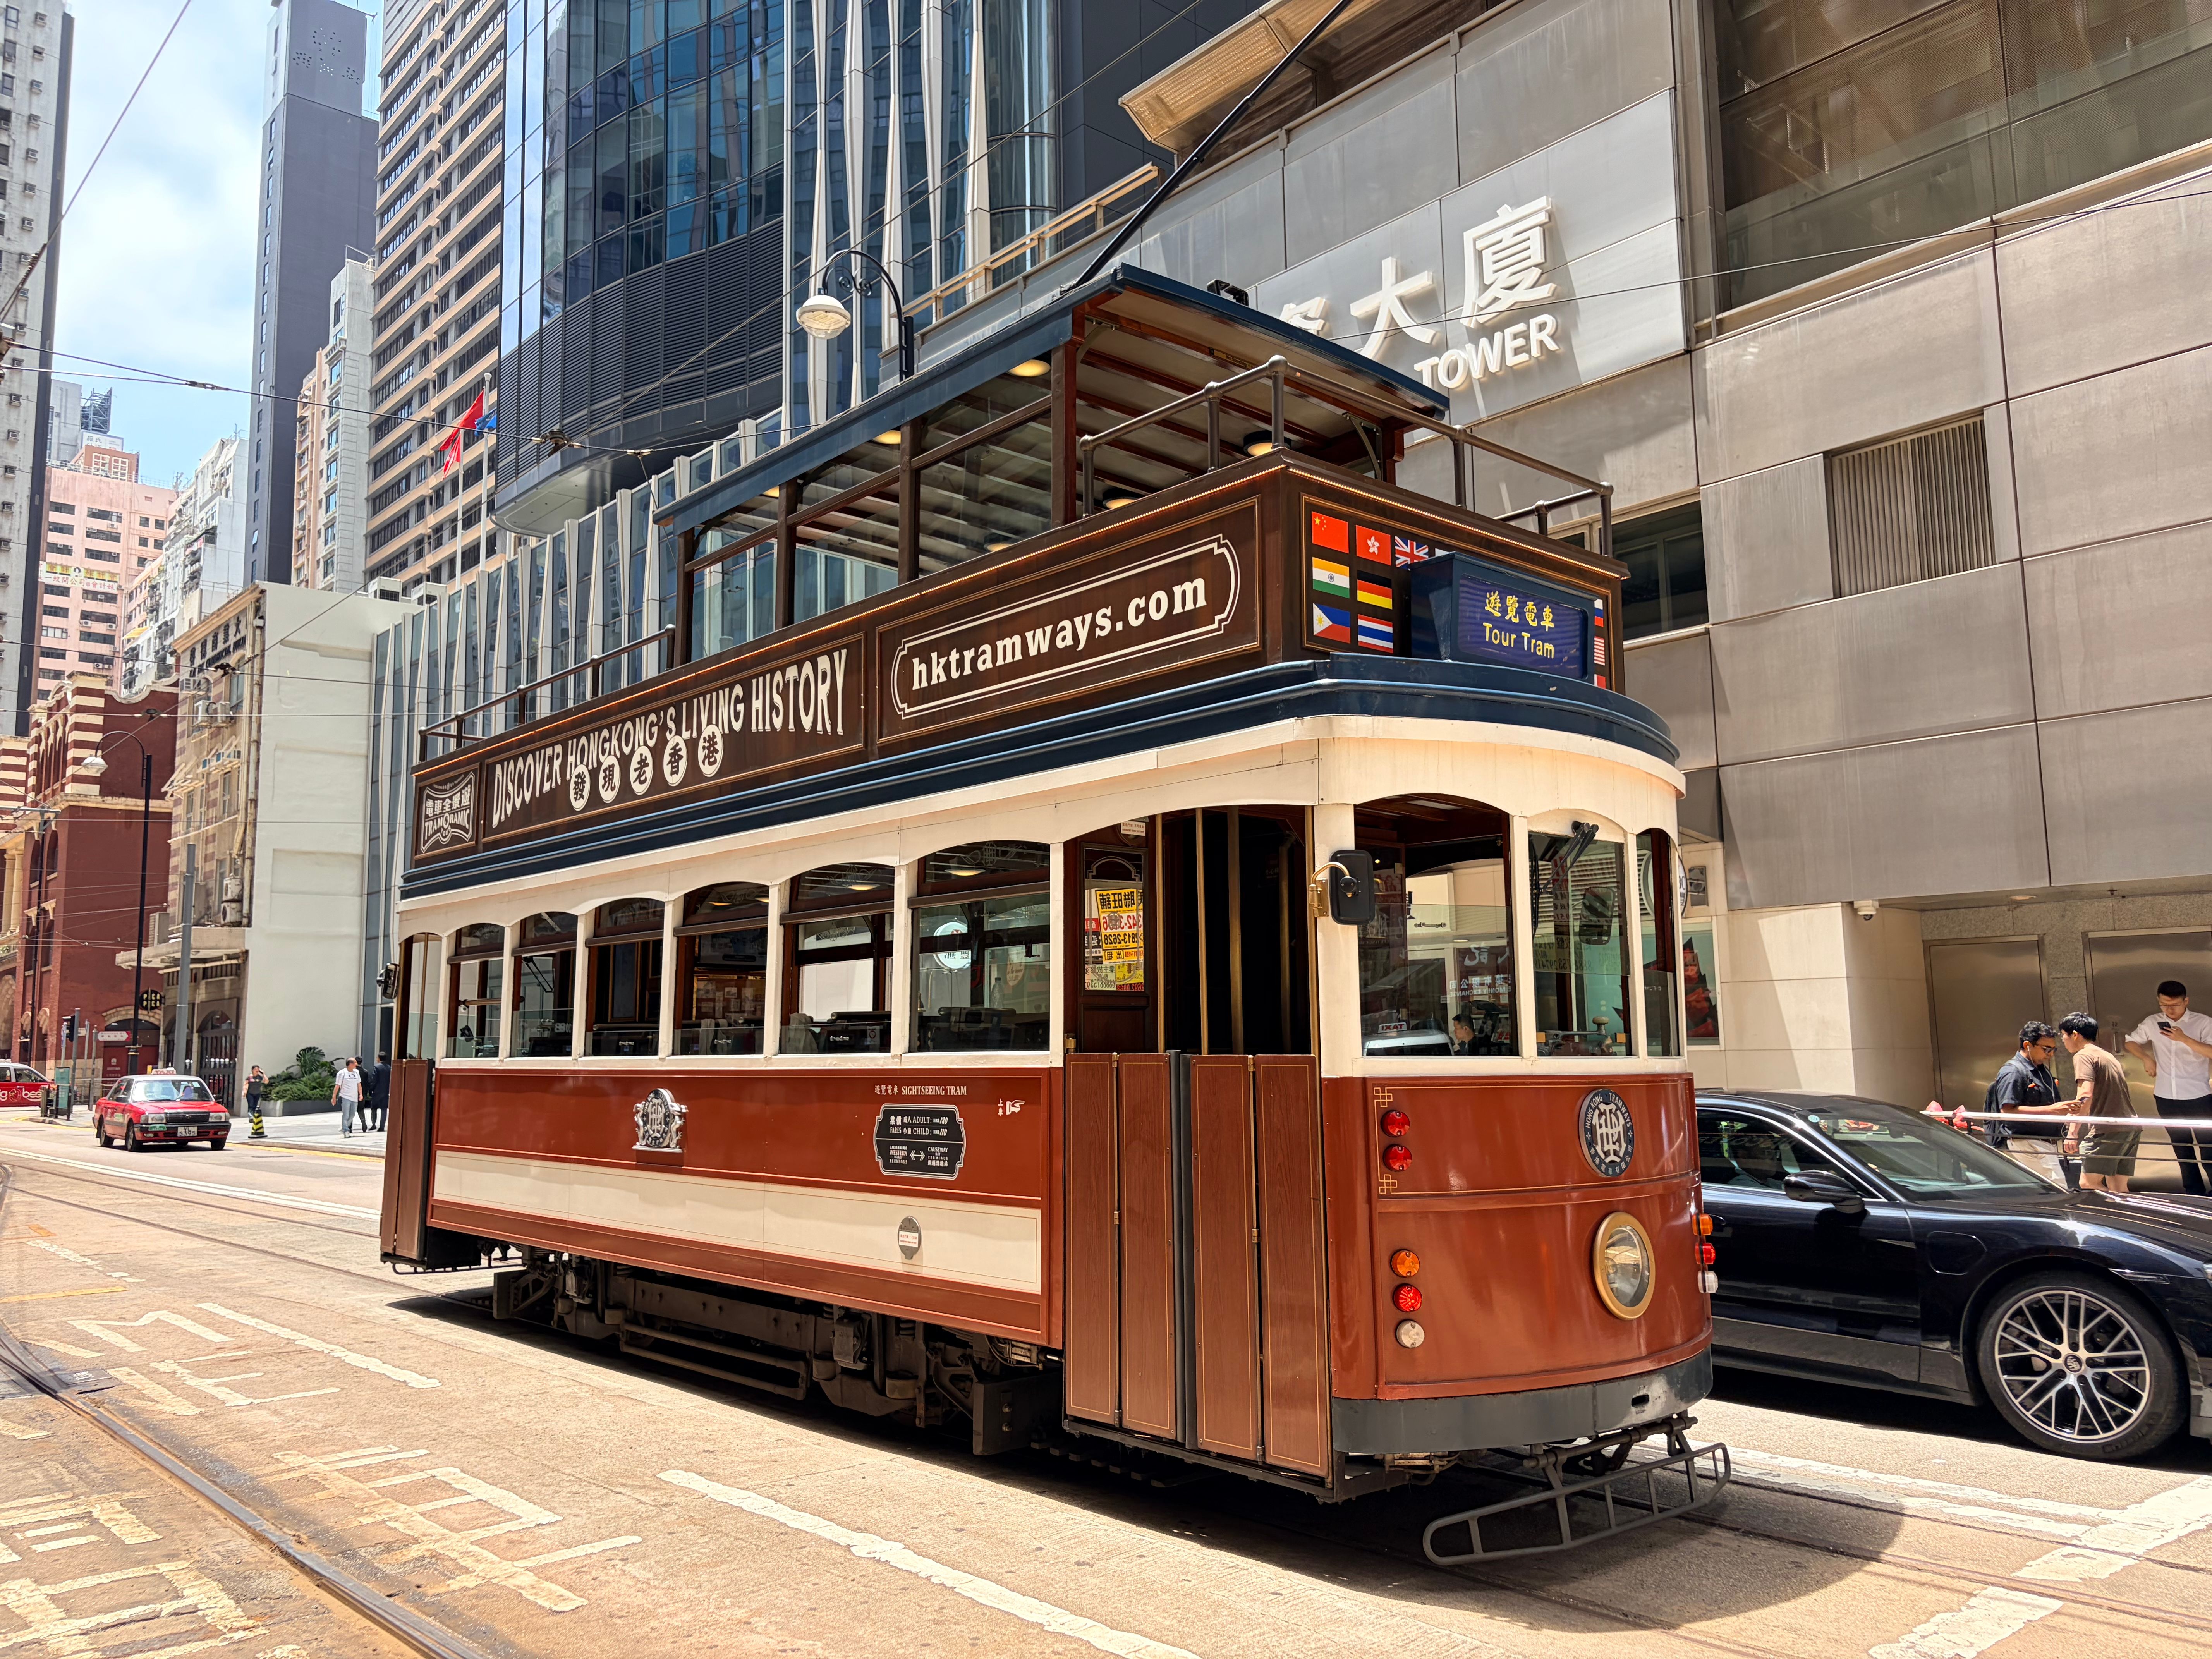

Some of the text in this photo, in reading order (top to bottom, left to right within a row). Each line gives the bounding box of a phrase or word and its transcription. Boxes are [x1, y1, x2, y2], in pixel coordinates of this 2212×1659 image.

[1414, 314, 1559, 388] TOWER
[1484, 590, 1555, 632] 遊覽電車
[912, 577, 1207, 691] hktramways.com
[1483, 622, 1555, 659] Tour Tram
[491, 744, 563, 828] DISCOVER
[682, 684, 745, 740] LIVING
[751, 648, 847, 735] HISTORY
[572, 730, 721, 802] 發現老香港
[426, 784, 471, 817] 電車全景遊
[425, 809, 470, 840] TRAMORAMIC
[874, 1085, 898, 1095] 遊覽電車
[902, 1086, 967, 1095] SIGHTSEEING TRAM
[1585, 1093, 1632, 1128] HONG KONG TRAMWAYS
